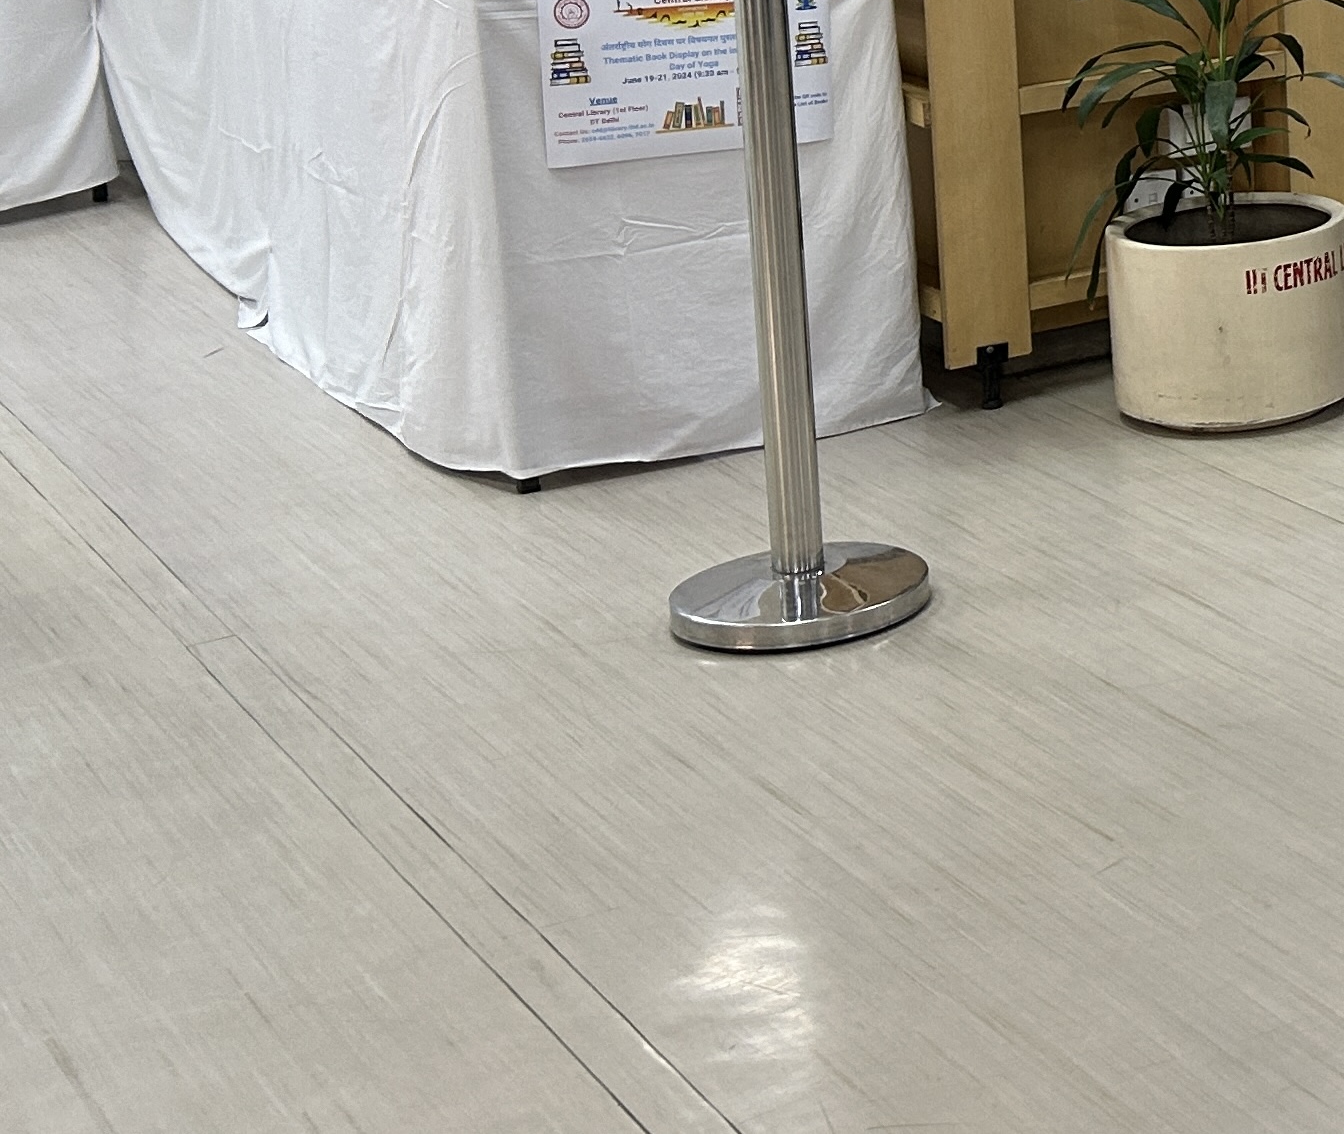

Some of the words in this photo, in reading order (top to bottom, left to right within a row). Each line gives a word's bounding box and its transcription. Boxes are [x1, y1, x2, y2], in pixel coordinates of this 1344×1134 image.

[604, 55, 643, 64] Thematic
[646, 52, 667, 61] Book
[669, 50, 699, 60] Display
[669, 63, 685, 71] Day
[697, 60, 719, 68] Yoga
[622, 77, 642, 85] June
[672, 72, 692, 80] 2024
[589, 96, 618, 106] Venue
[558, 110, 585, 119] Central
[586, 108, 611, 117] Library
[1274, 250, 1338, 292] CENTRAL
